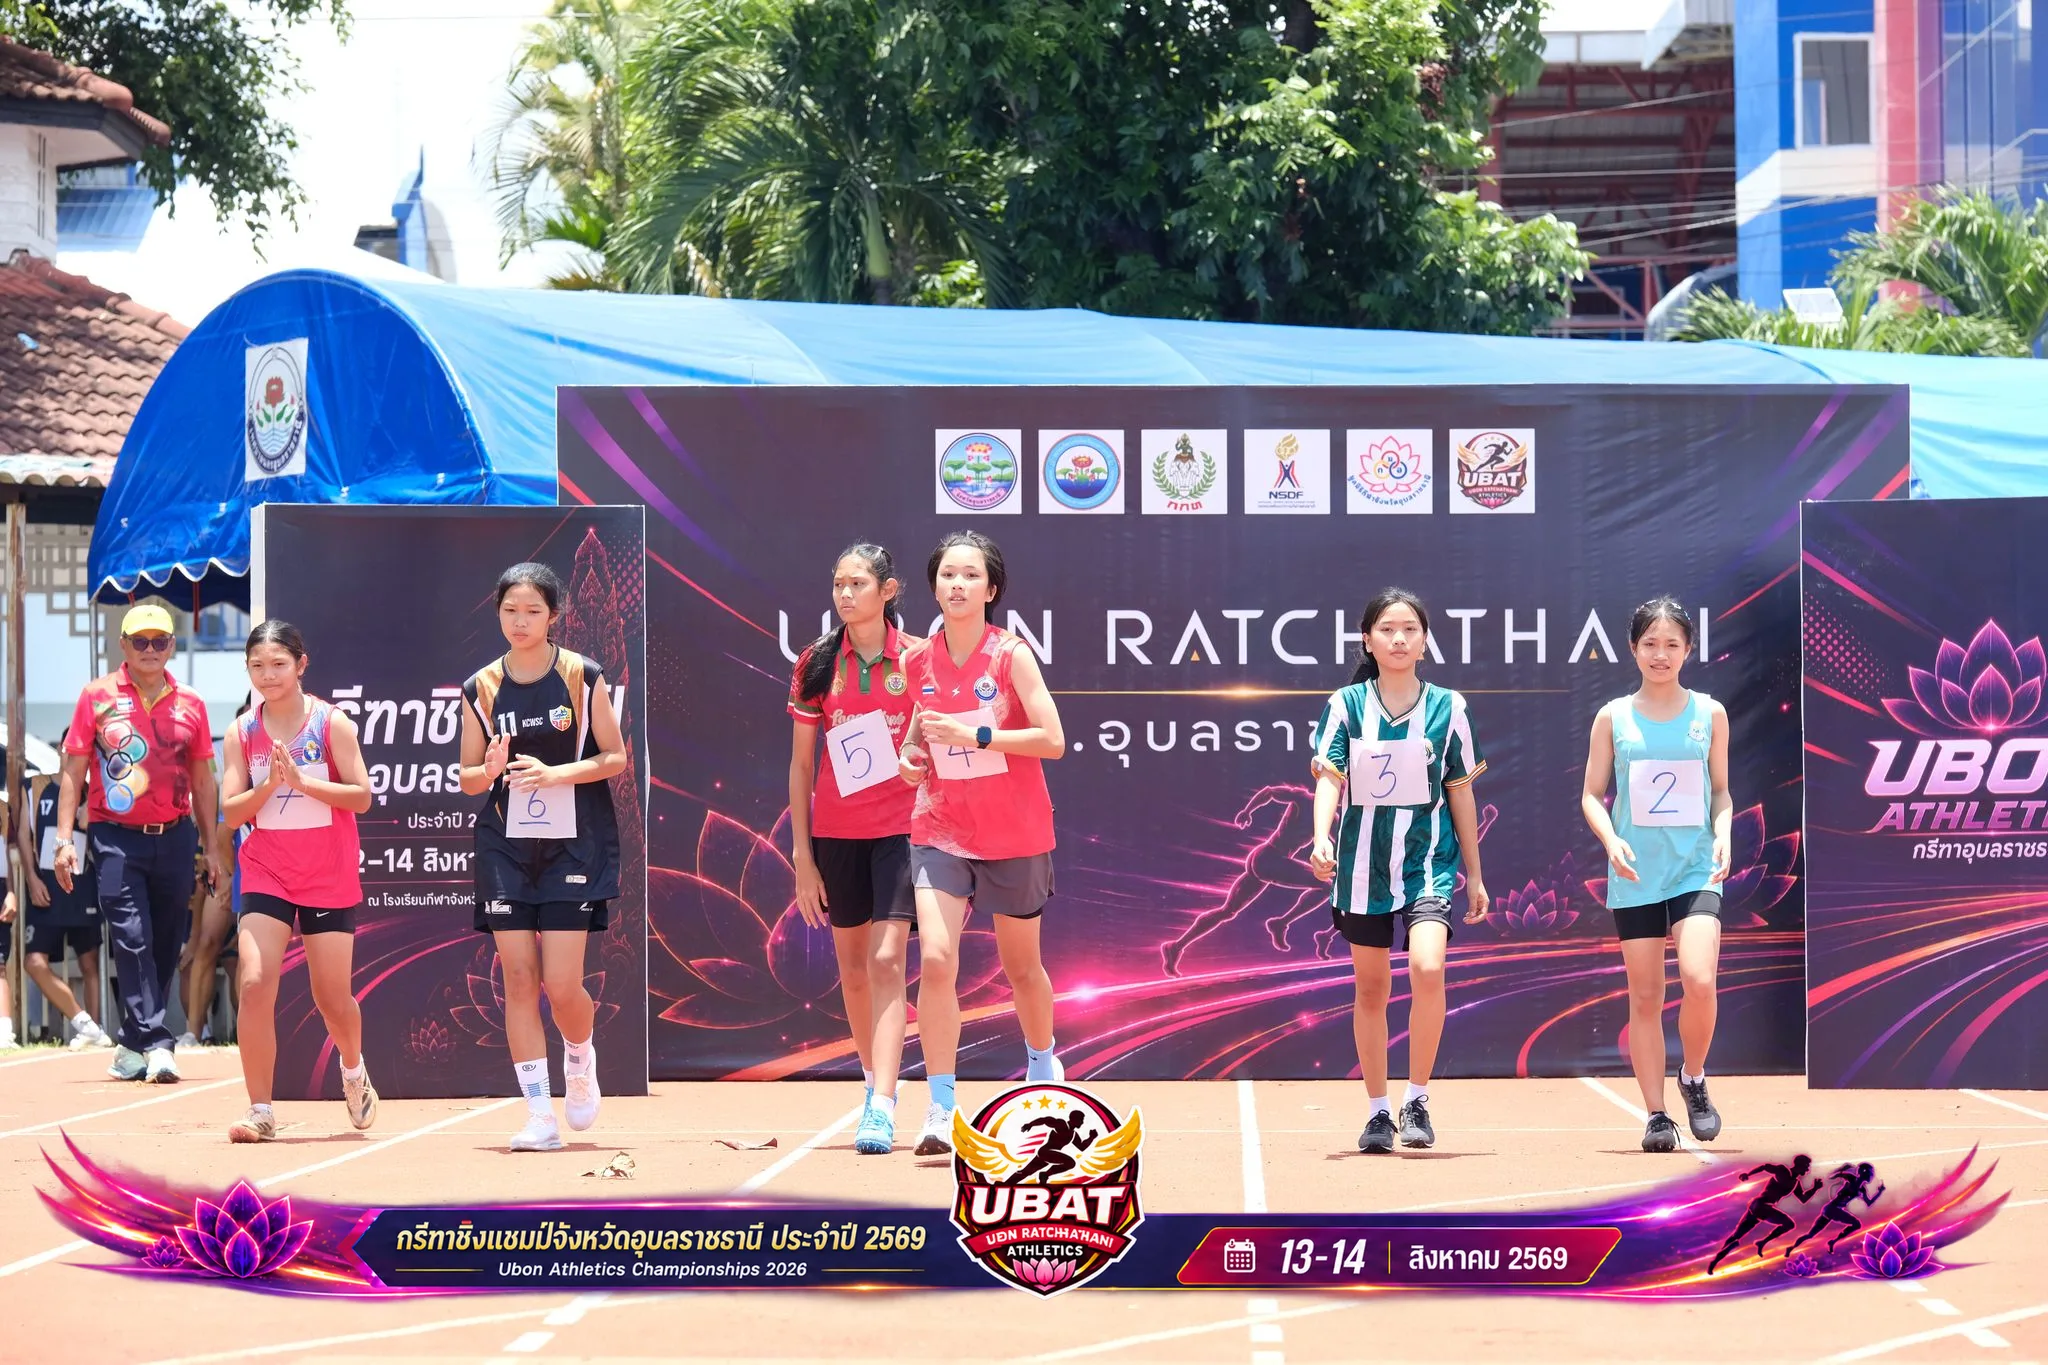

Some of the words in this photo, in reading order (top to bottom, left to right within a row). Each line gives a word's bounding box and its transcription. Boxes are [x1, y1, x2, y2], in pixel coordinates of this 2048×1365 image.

[1463, 472, 1522, 487] UBAT
[1268, 490, 1304, 500] NSDF
[1106, 608, 1709, 665] RATCHTHAI
[497, 711, 518, 738] 11
[521, 716, 544, 728] KCWSC
[841, 731, 872, 779] 5
[369, 763, 463, 806] อุบลร
[1370, 754, 1397, 799] 3
[525, 789, 548, 820] 6
[1649, 772, 1679, 814] 2
[40, 799, 54, 816] 17
[408, 811, 462, 828] ประจำปี
[467, 813, 477, 828] 2
[359, 848, 414, 873] 2-14
[367, 896, 380, 907] ณ
